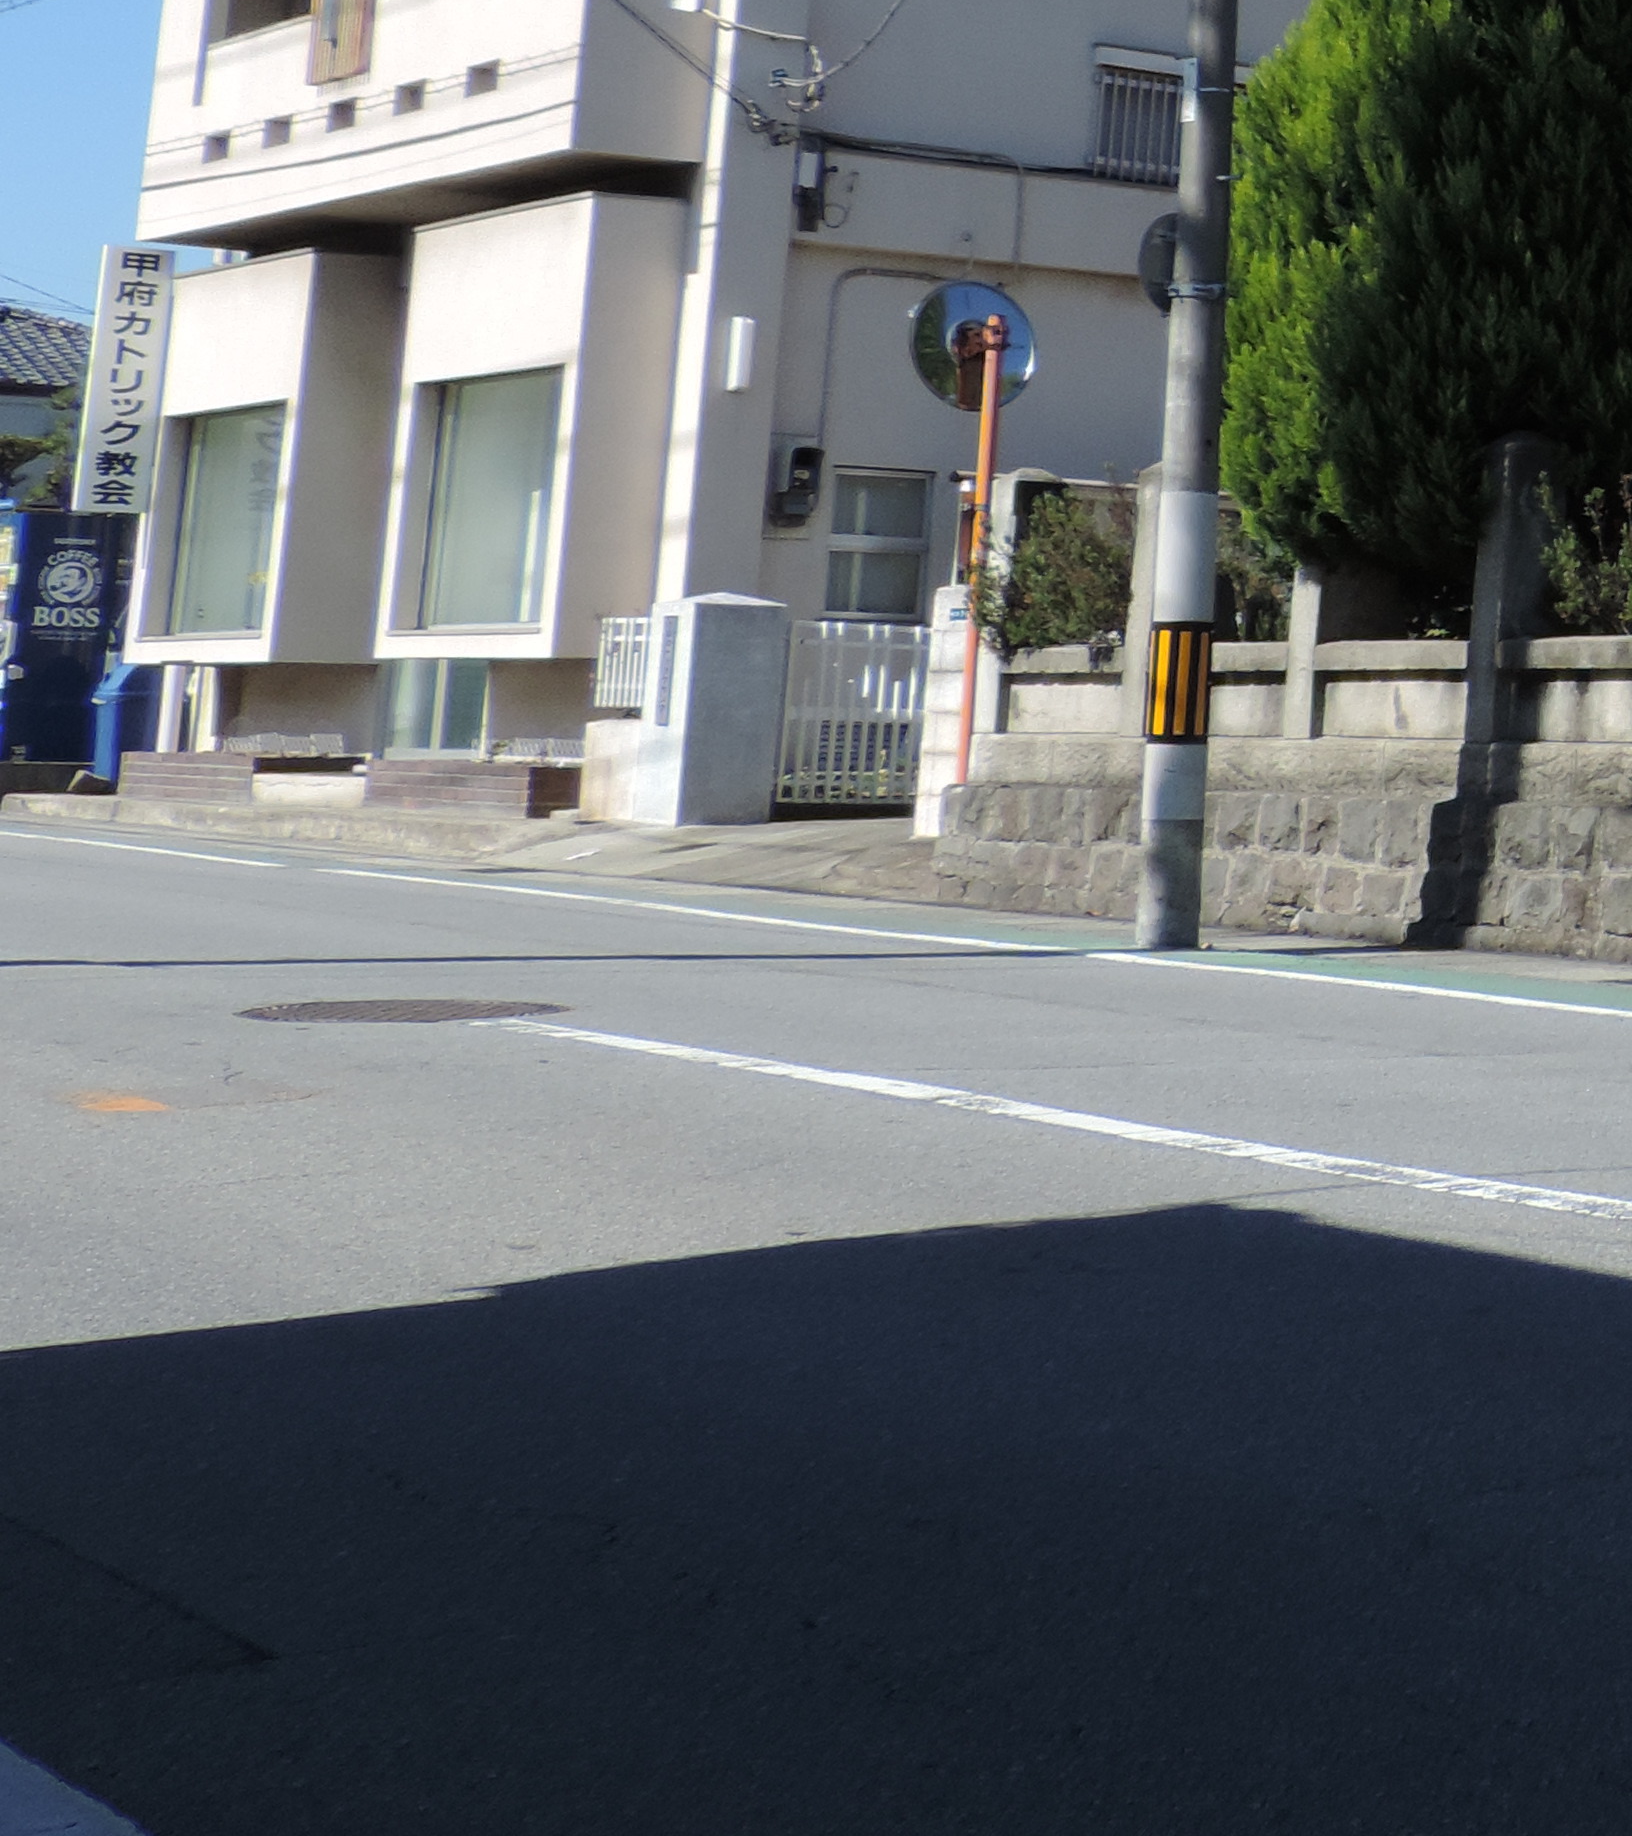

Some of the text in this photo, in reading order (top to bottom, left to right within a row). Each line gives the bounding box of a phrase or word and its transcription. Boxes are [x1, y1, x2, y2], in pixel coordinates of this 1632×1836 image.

[93, 251, 160, 505] 甲府カトリック教会
[47, 549, 99, 567] COFFEE
[31, 606, 100, 628] BOSS
